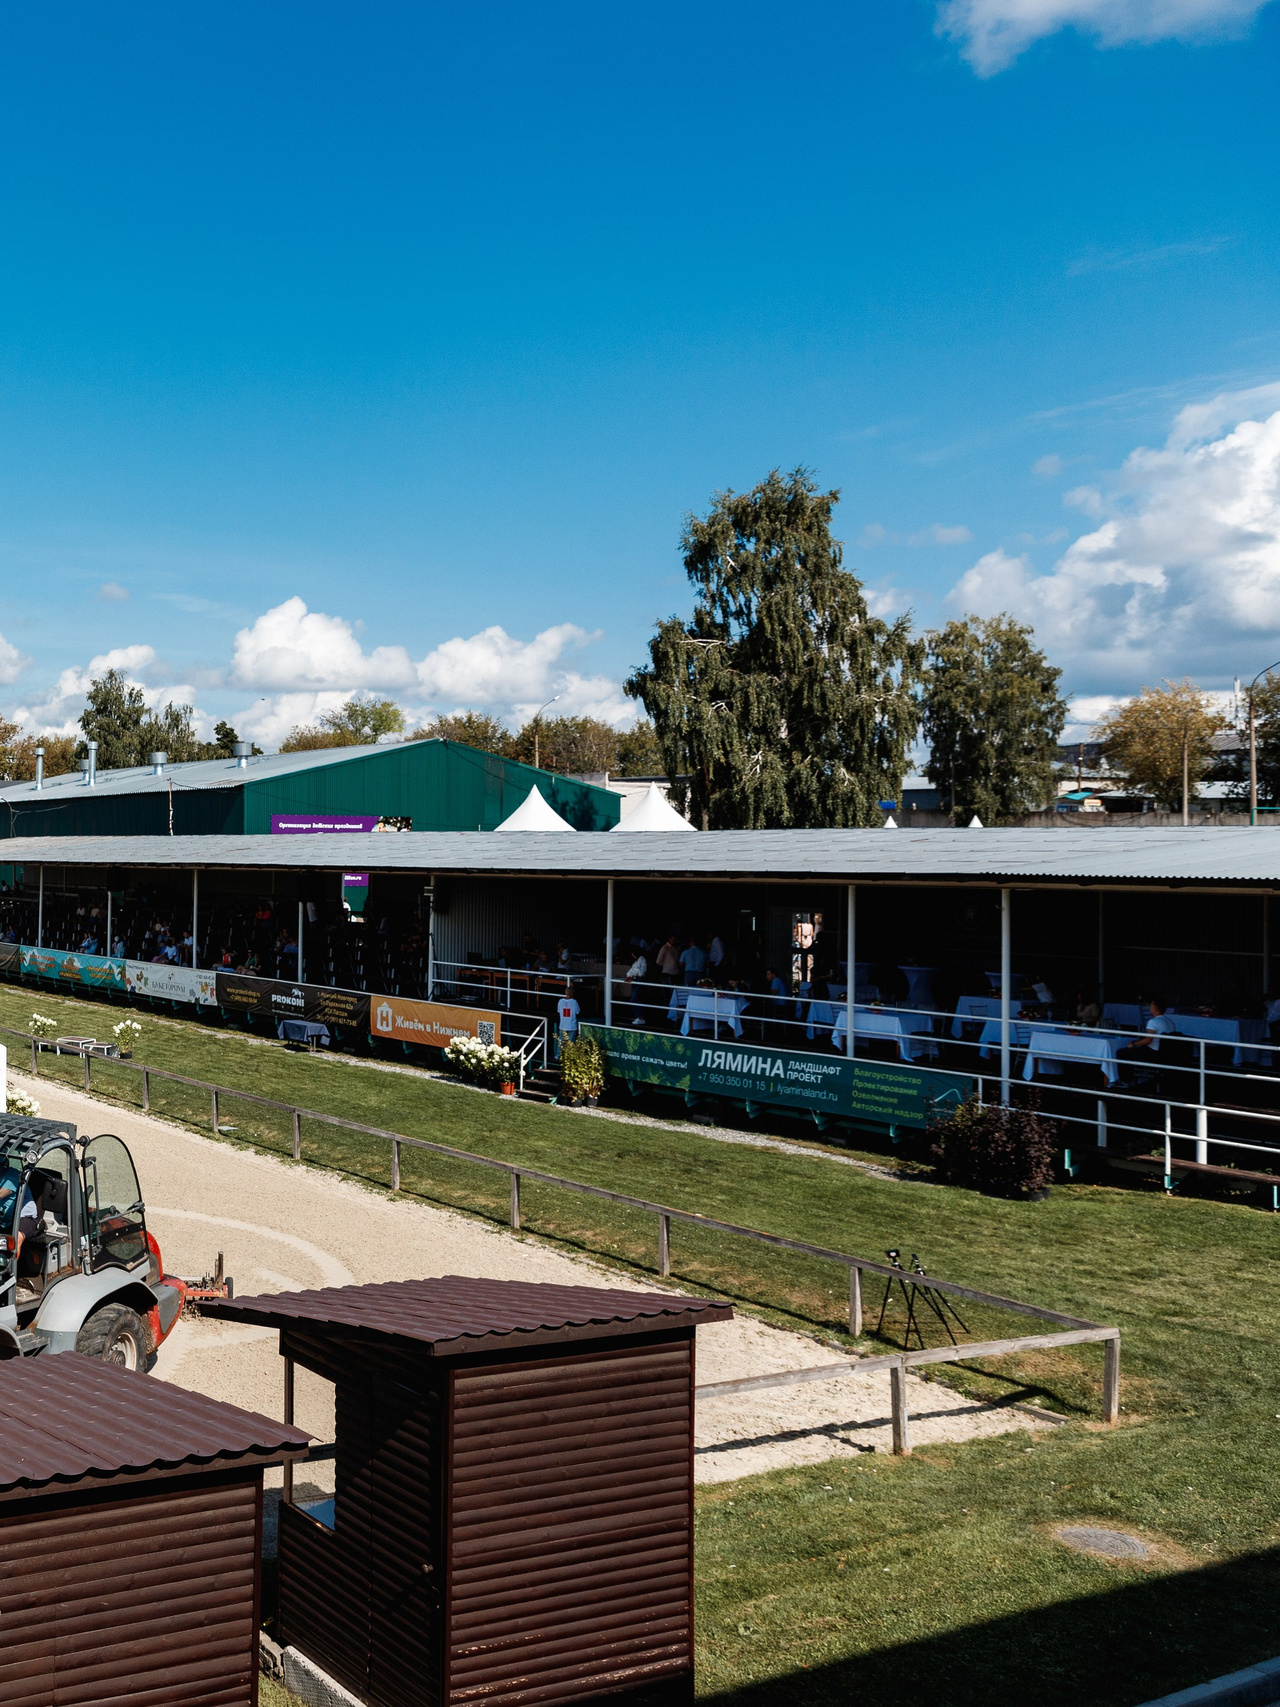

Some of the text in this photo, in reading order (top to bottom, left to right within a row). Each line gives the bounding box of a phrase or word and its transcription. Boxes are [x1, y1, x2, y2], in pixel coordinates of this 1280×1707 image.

[271, 994, 305, 1007] PROKONI
[395, 1015, 470, 1038] Живём в Нижнем
[621, 1052, 640, 1061] время
[641, 1055, 665, 1066] сажать
[665, 1060, 688, 1069] цветы!
[698, 1048, 785, 1079] ЛЯМИНА
[788, 1060, 842, 1076] ЛАНДШАФТ
[698, 1072, 766, 1091] +7 950 350 01 15
[787, 1071, 823, 1084] ПРОЕКТ
[854, 1068, 922, 1085] Благоустройство
[777, 1083, 838, 1101] lyaminaland.ru
[852, 1079, 918, 1096] Проектирование
[851, 1090, 898, 1104] Озеленение
[851, 1101, 924, 1120] Авторский надзор
